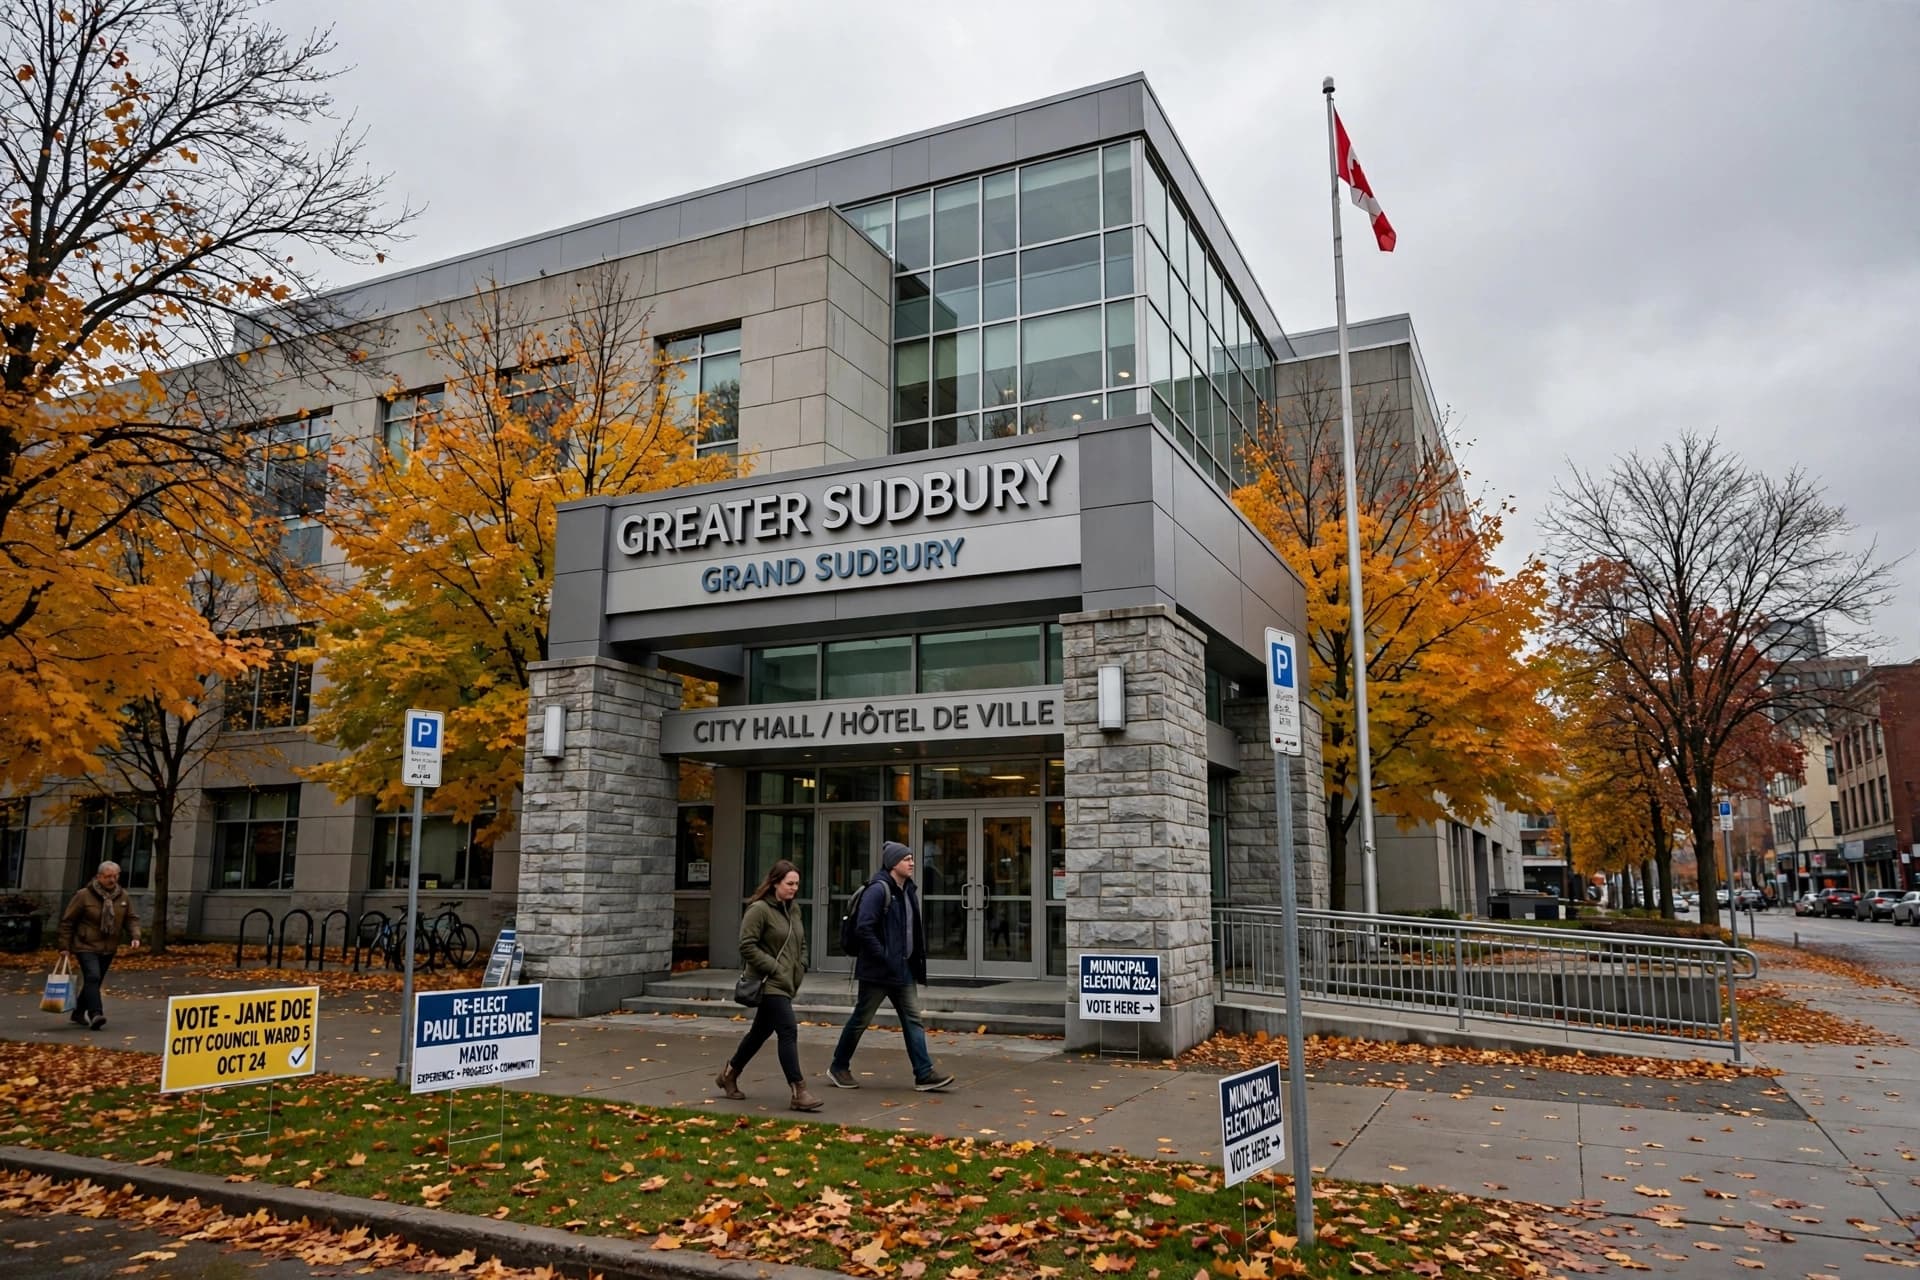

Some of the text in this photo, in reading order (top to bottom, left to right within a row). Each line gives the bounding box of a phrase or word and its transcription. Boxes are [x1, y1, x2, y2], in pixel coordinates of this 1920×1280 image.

[616, 453, 1062, 556] GREATER SUDBURY
[701, 537, 964, 593] GRAND SUDBURY
[1276, 648, 1289, 679] P
[418, 721, 432, 742] P
[693, 700, 1054, 743] CITY HALL / HÔTEL DE VILLE
[1090, 960, 1149, 975] MUNICIPAL
[1083, 975, 1157, 991] ELECTION 2024
[175, 1005, 220, 1031] VOTE
[234, 1000, 276, 1025] JANE
[281, 998, 312, 1021] DOE
[453, 996, 508, 1016] RE-ELECT
[1086, 999, 1140, 1015] VOTE HERE
[172, 1025, 311, 1055] CITY COUNCIL WARD 5
[423, 1011, 533, 1042] PAUL LEFEBVRE
[217, 1051, 266, 1075] OCT 24
[459, 1044, 498, 1065] MAYOR
[417, 1069, 455, 1084] EXPERIENCE
[500, 1059, 535, 1073] COMMUNITY
[1228, 1075, 1273, 1113] MUNICIPAL
[1225, 1096, 1280, 1141] ELECTION 2024
[1230, 1136, 1271, 1174] VOTE HERE
